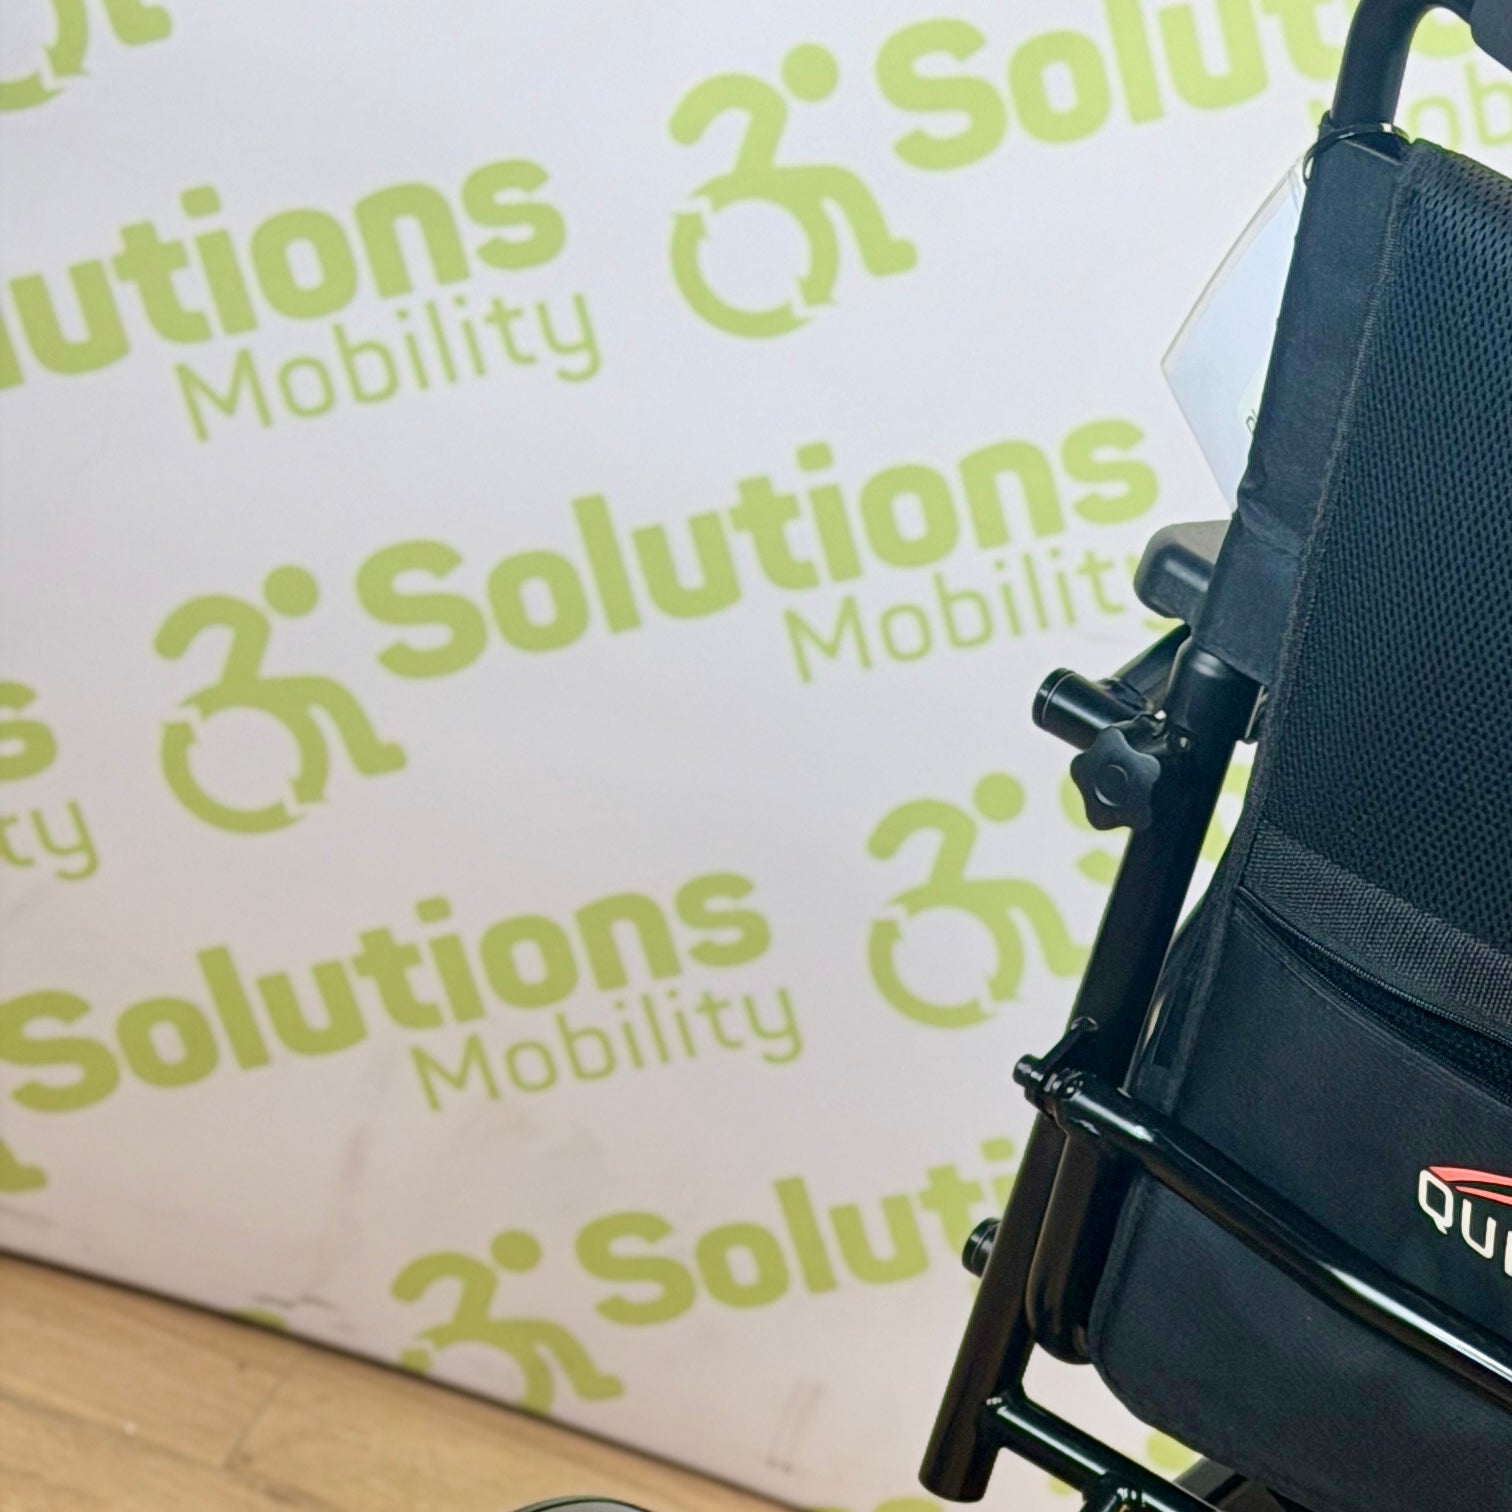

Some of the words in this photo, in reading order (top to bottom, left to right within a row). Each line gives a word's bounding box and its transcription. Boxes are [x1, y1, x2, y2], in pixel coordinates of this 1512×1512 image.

[0, 158, 568, 392] utions
[174, 294, 602, 443] Mobility
[354, 418, 1159, 682] Solutions
[0, 871, 772, 1114] Solutions
[409, 985, 804, 1114] Mobility
